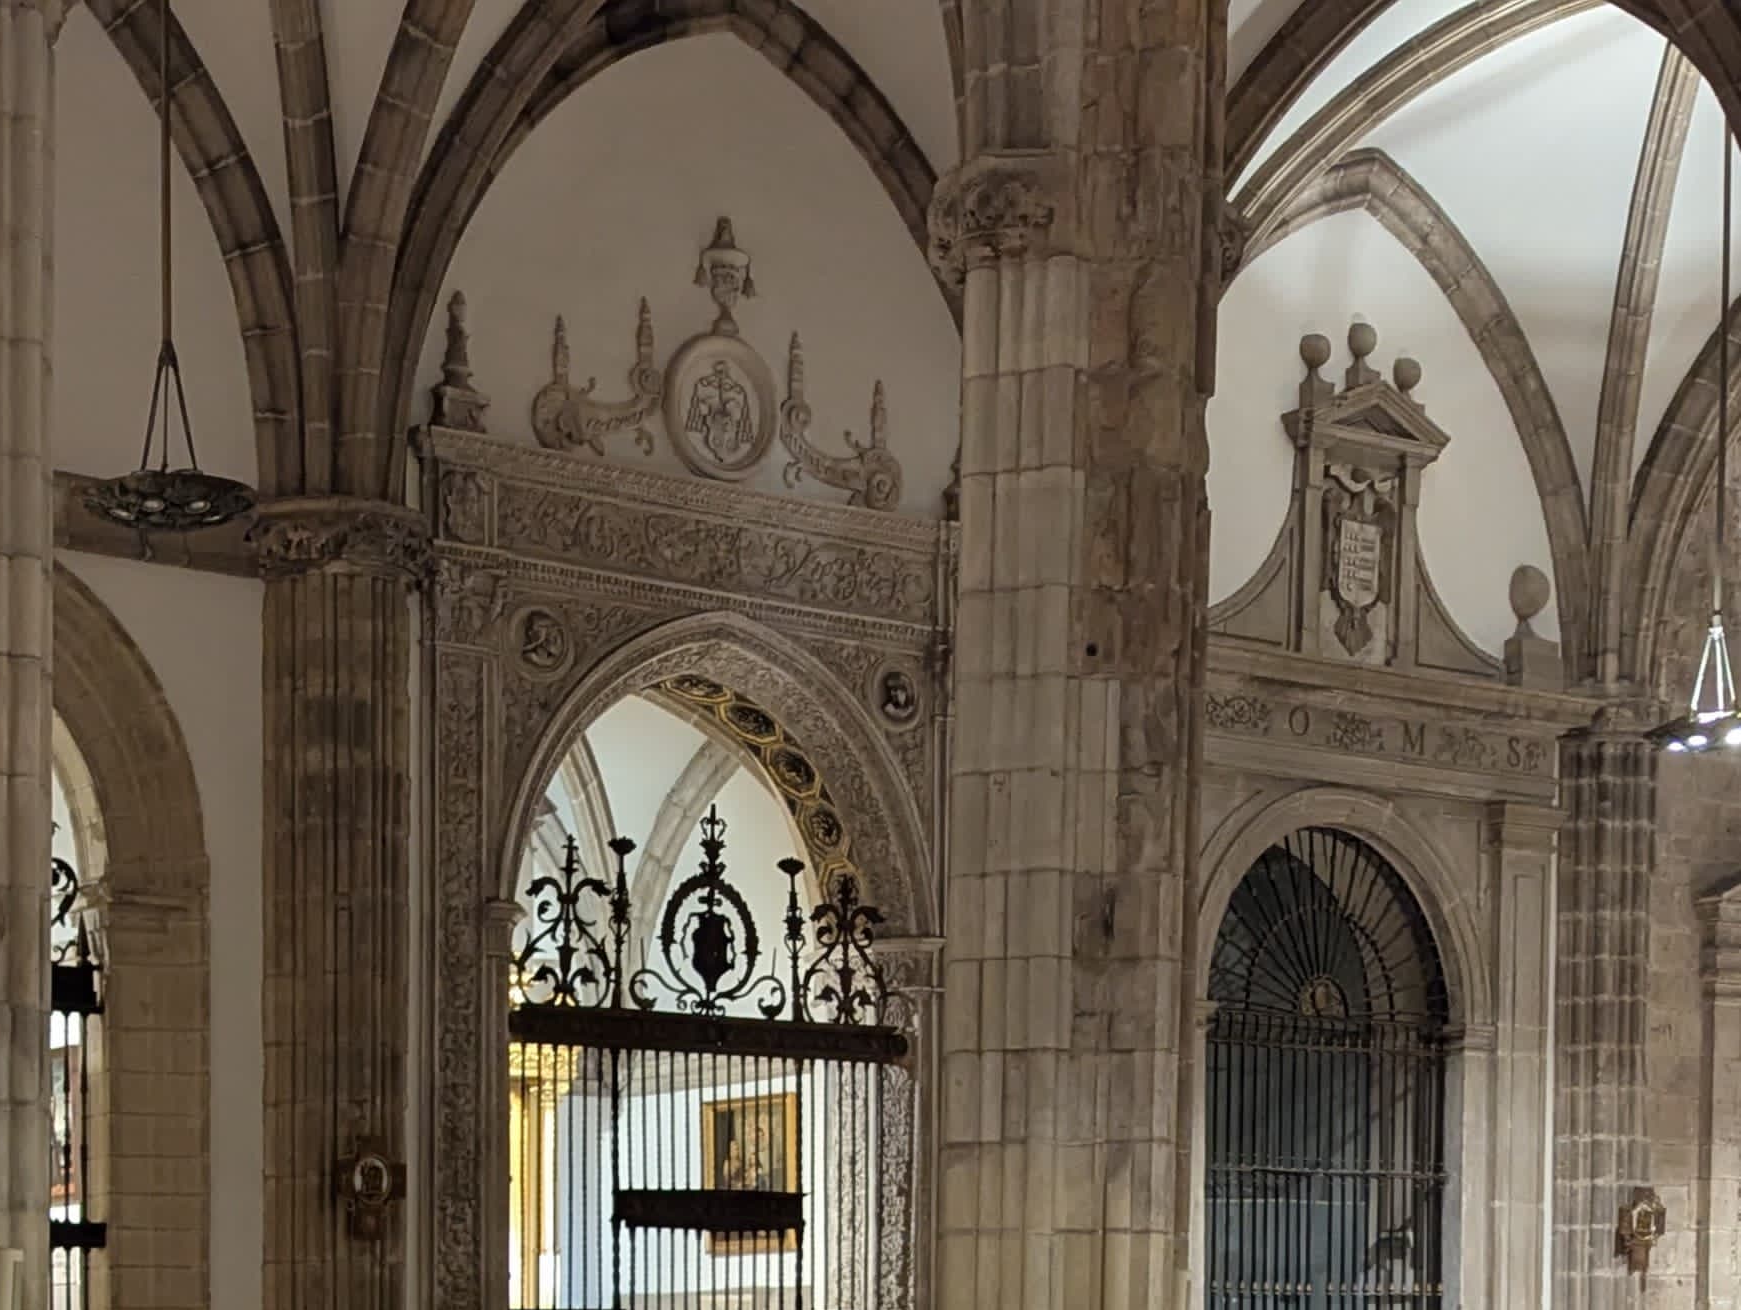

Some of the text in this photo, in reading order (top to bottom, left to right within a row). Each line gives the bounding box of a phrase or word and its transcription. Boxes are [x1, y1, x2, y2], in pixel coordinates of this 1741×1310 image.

[1289, 705, 1521, 768] O M S
